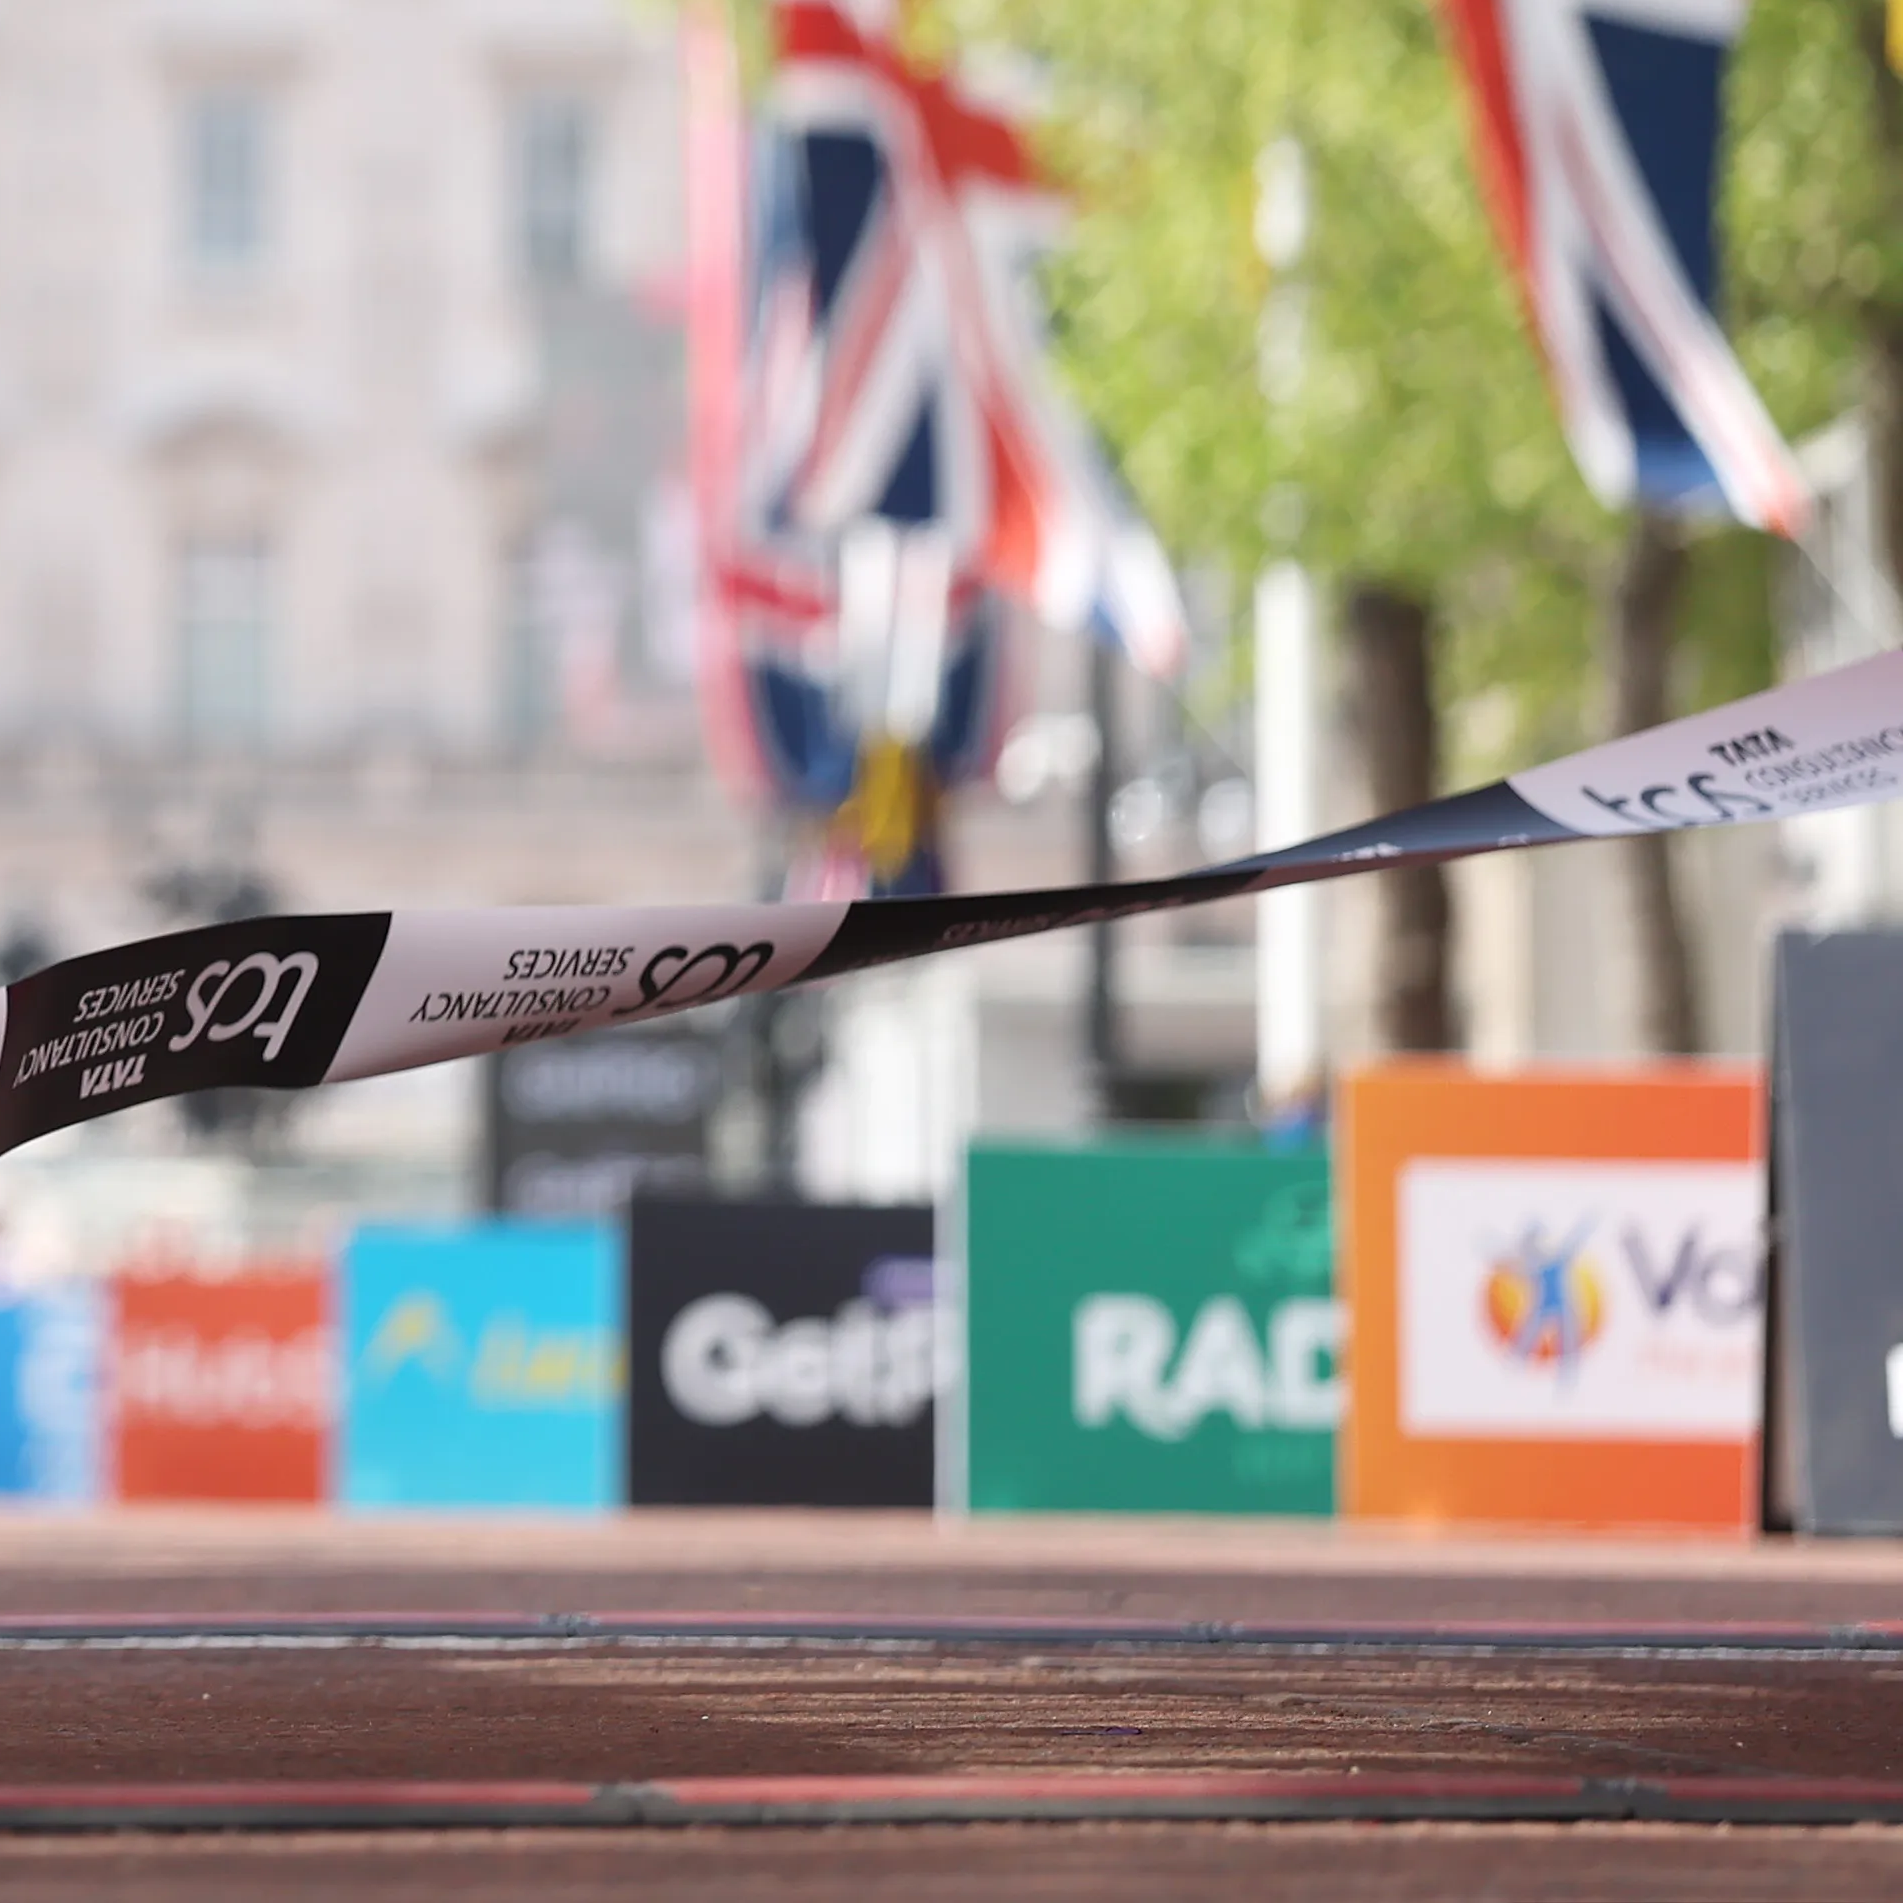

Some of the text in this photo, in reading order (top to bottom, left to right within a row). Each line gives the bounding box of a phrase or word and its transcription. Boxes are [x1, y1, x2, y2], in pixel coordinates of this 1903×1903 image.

[1708, 725, 1796, 768] TATA
[502, 946, 634, 981] SERVICES
[73, 968, 186, 1023] SERVICES
[168, 951, 320, 1062] tcs
[409, 985, 612, 1023] CONSULTANCY
[11, 1011, 166, 1089] CONSULTANCY
[79, 1053, 149, 1101] TATA
